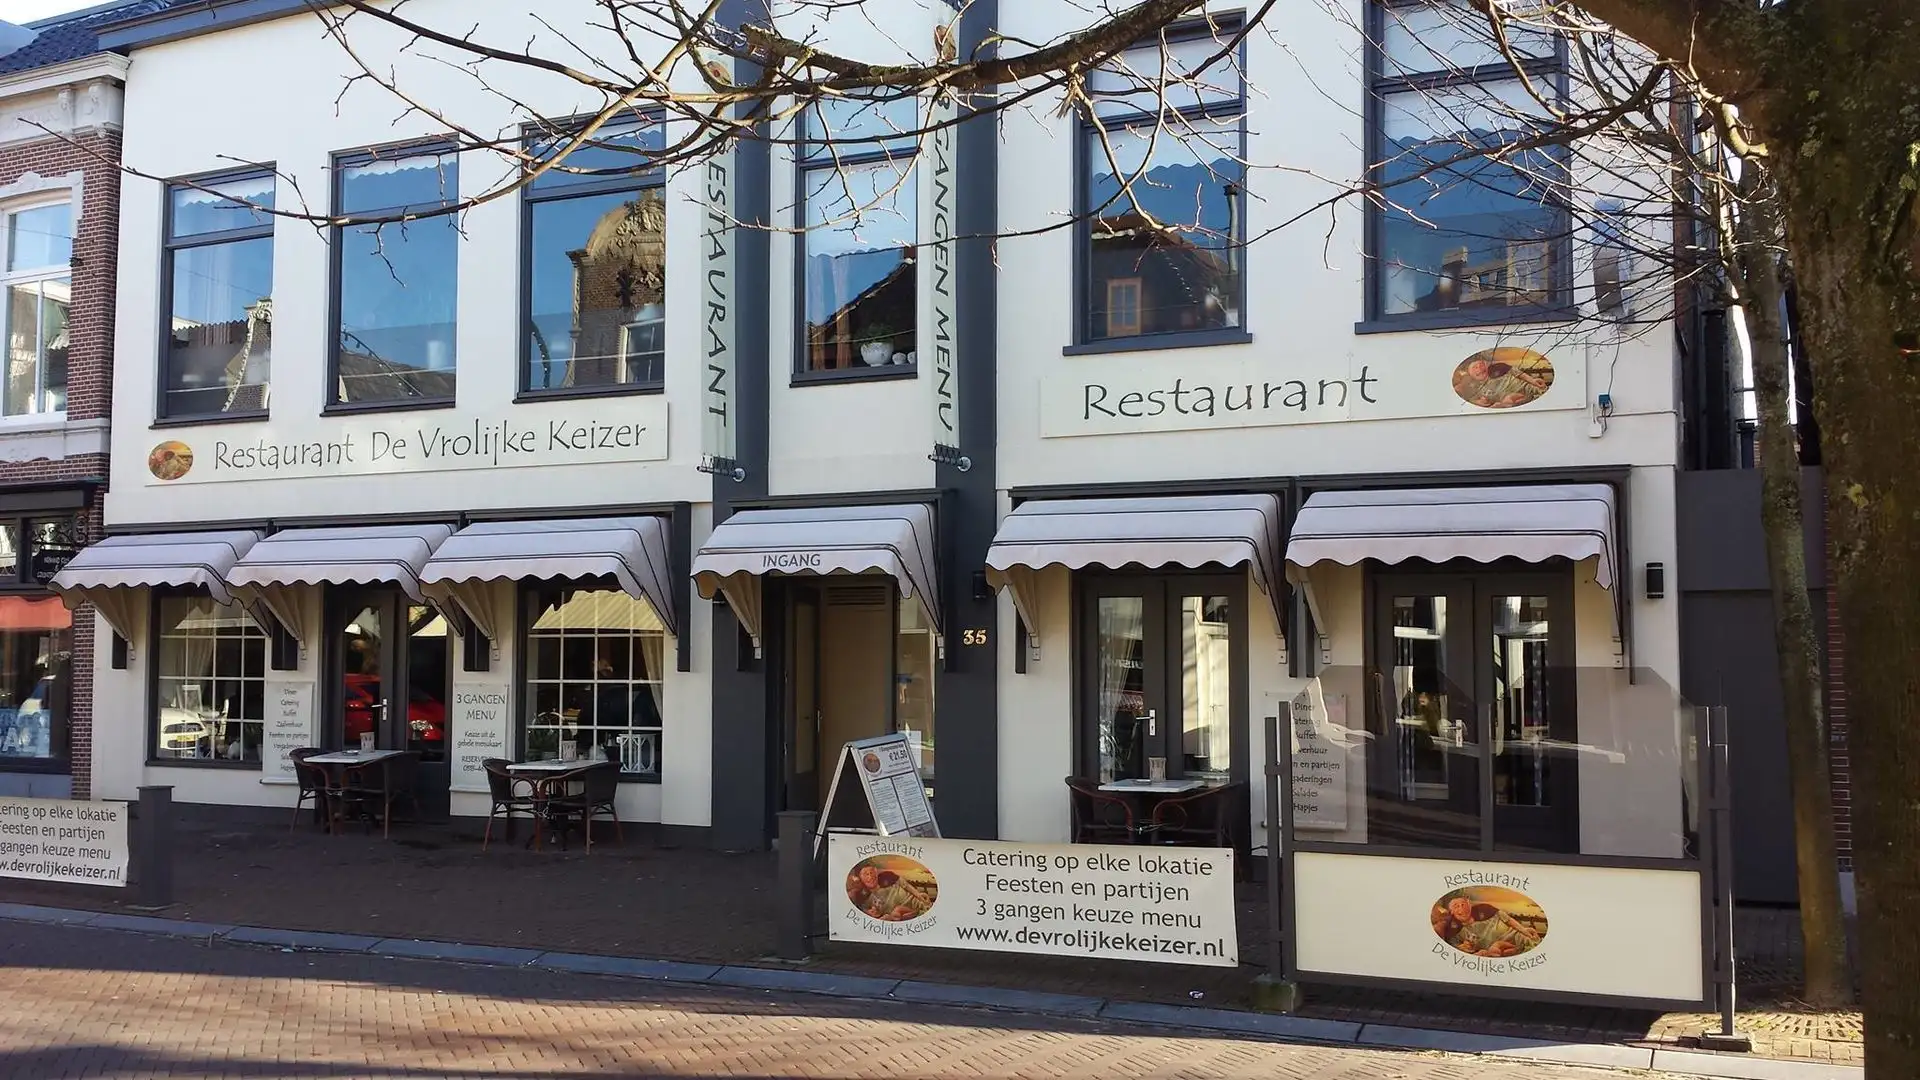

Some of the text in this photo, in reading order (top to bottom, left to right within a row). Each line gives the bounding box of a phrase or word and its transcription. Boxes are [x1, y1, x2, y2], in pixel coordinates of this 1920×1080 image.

[933, 120, 950, 297] GANGEN
[934, 307, 954, 433] MENU
[1083, 364, 1378, 420] Restaurant
[214, 418, 647, 470] Restaurant De Vrolijke Keizer
[762, 553, 821, 568] INGANG
[962, 629, 988, 646] 35
[456, 694, 506, 705] 3 GANGEN
[466, 710, 497, 721] MENU
[1299, 746, 1328, 755] verhuur
[1300, 761, 1310, 769] en
[1311, 760, 1340, 771] partijen
[0, 803, 117, 822] ering op elke lokatie
[41, 825, 56, 837] en
[59, 826, 106, 842] partijen
[0, 840, 111, 860] gangen keuze menu
[856, 839, 924, 860] Restaurant
[963, 848, 1214, 876] Catering op elke lokatie
[985, 873, 1191, 904] Feesten en partijen
[1443, 868, 1531, 891] Restaurant
[845, 907, 939, 940] De Vrolijke Keizer
[976, 898, 1203, 929] 3 gangen keuze menu
[956, 924, 1225, 958] www.devrolijkekeizer.nl
[1431, 942, 1548, 977] De Vrolijke Keizer
